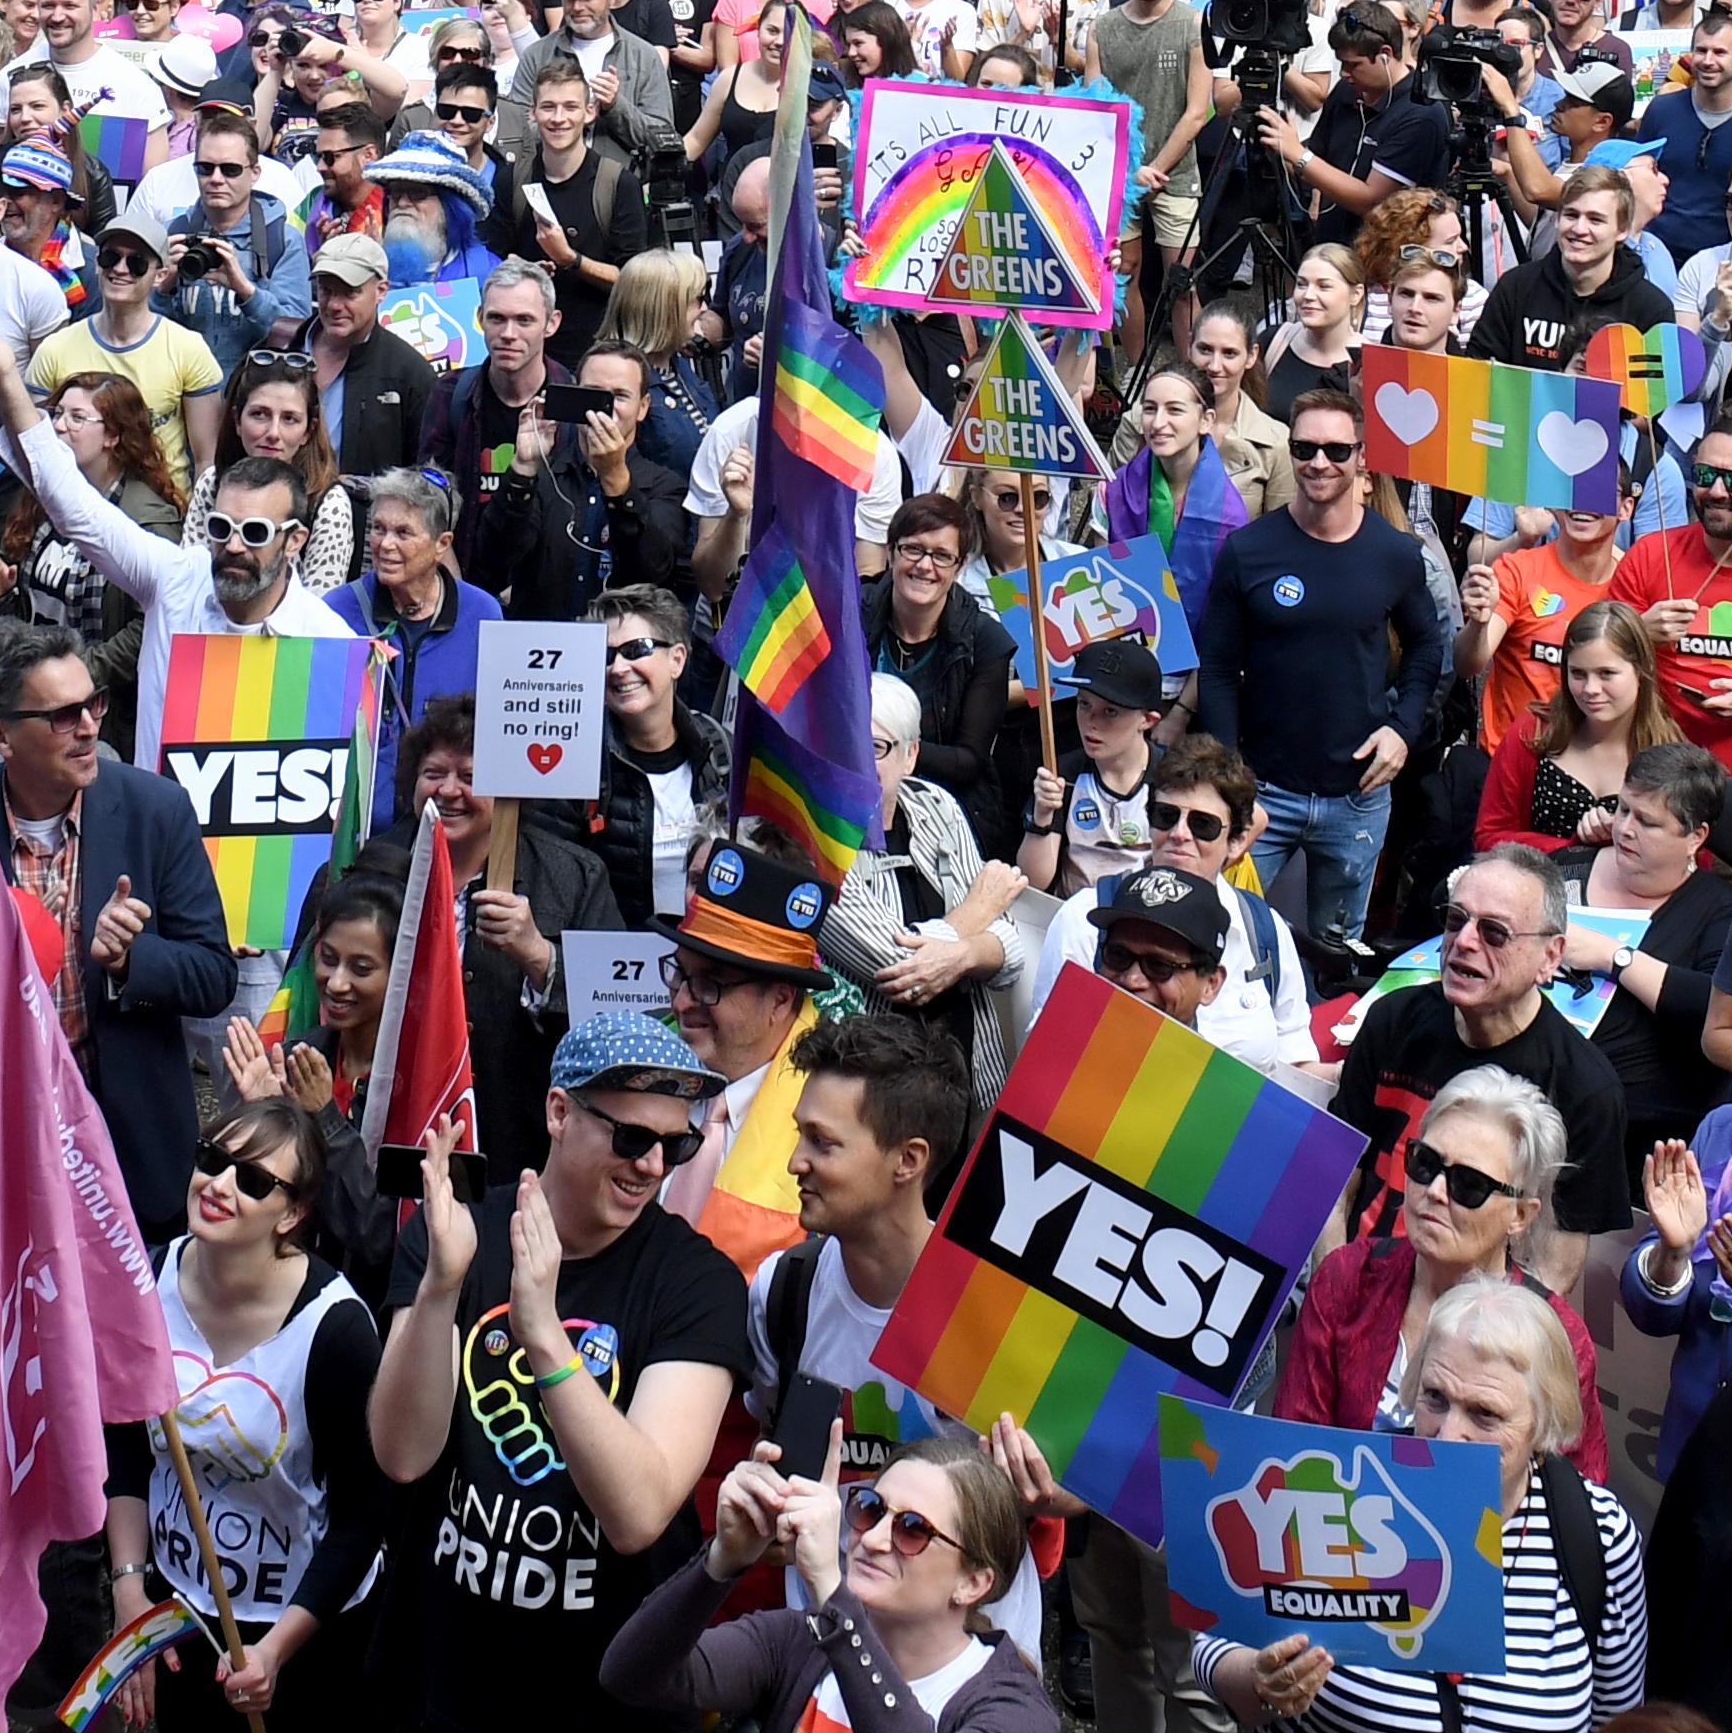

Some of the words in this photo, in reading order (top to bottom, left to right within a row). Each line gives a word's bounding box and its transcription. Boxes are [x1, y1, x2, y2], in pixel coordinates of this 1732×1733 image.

[867, 138, 909, 184] IT'S
[918, 110, 964, 147] ALL
[993, 106, 1054, 144] FUN
[974, 210, 1031, 253] THE
[948, 251, 1064, 297] GREENS
[398, 312, 450, 355] ES
[987, 375, 1044, 417] THE
[963, 415, 1078, 465] GREENS
[1042, 578, 1139, 648] YES
[527, 649, 563, 670] 27
[502, 678, 585, 694] Anniversaries
[502, 697, 540, 714] and
[545, 698, 582, 715] still
[502, 721, 528, 736] no
[534, 721, 579, 742] ring!
[166, 748, 351, 827] YES!
[611, 959, 646, 982] 27
[591, 989, 671, 1005] Anniversaries
[989, 1128, 1265, 1367] YES!
[448, 1466, 599, 1553] UNION
[1234, 1487, 1407, 1579] YES
[434, 1515, 597, 1611] PRIDE
[1269, 1589, 1402, 1618] EQUALITY
[66, 1608, 187, 1718] YES
